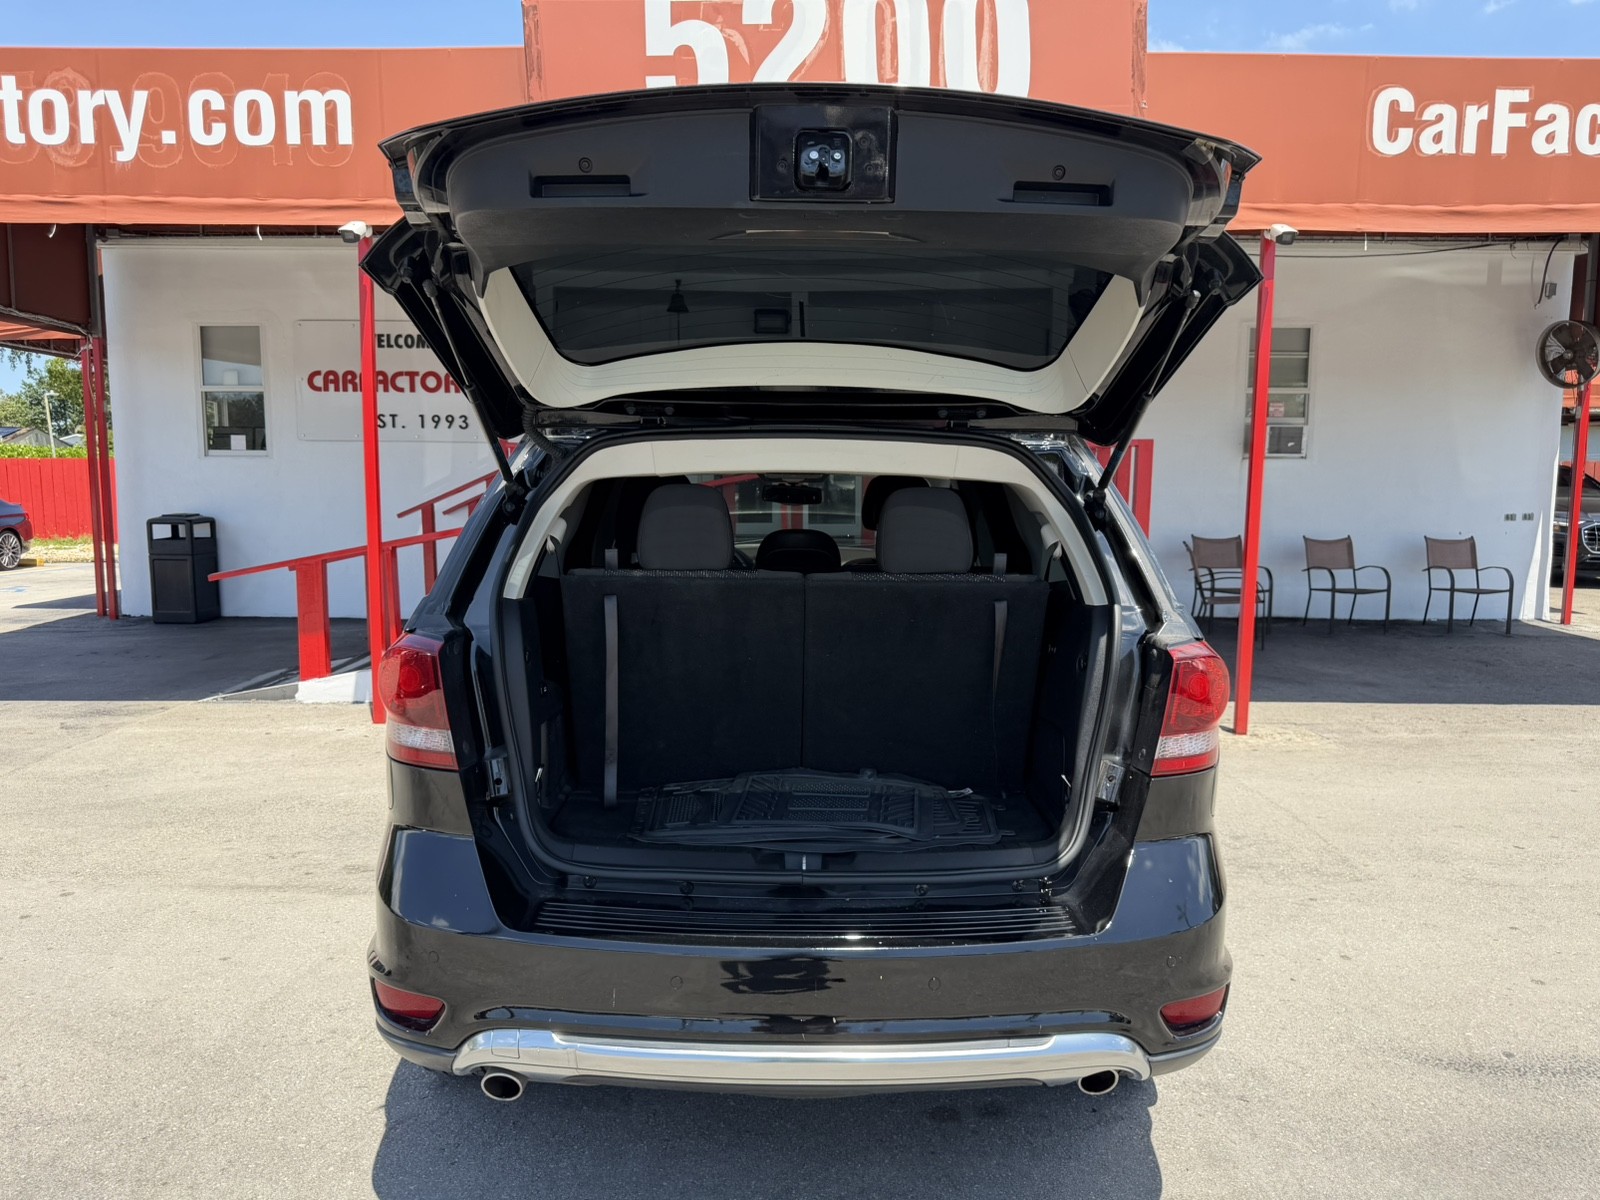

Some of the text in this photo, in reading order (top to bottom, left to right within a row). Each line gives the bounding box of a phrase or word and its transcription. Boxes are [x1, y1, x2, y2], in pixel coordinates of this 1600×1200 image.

[645, 0, 1031, 98] 5200
[0, 75, 353, 162] tory.com
[1372, 86, 1600, 156] CarFac
[374, 333, 432, 349] ELCOM
[307, 370, 461, 393] CARACTOR
[377, 413, 469, 430] ST. 1993
